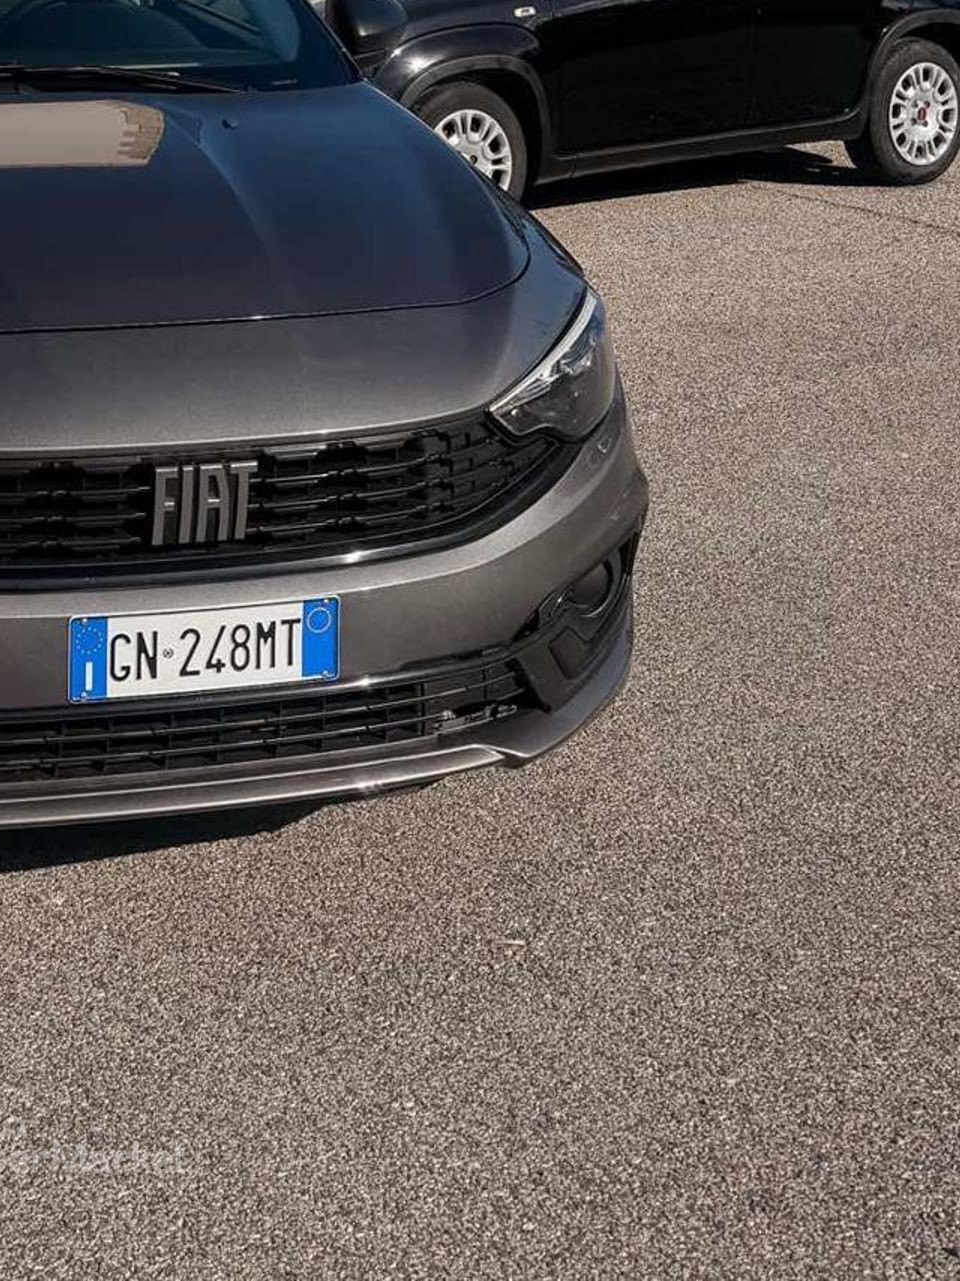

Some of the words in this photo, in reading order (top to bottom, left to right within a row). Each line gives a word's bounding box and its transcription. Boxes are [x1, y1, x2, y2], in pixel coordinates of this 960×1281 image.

[151, 460, 259, 546] FIAT
[109, 630, 159, 682] GN
[179, 617, 302, 678] 248MT
